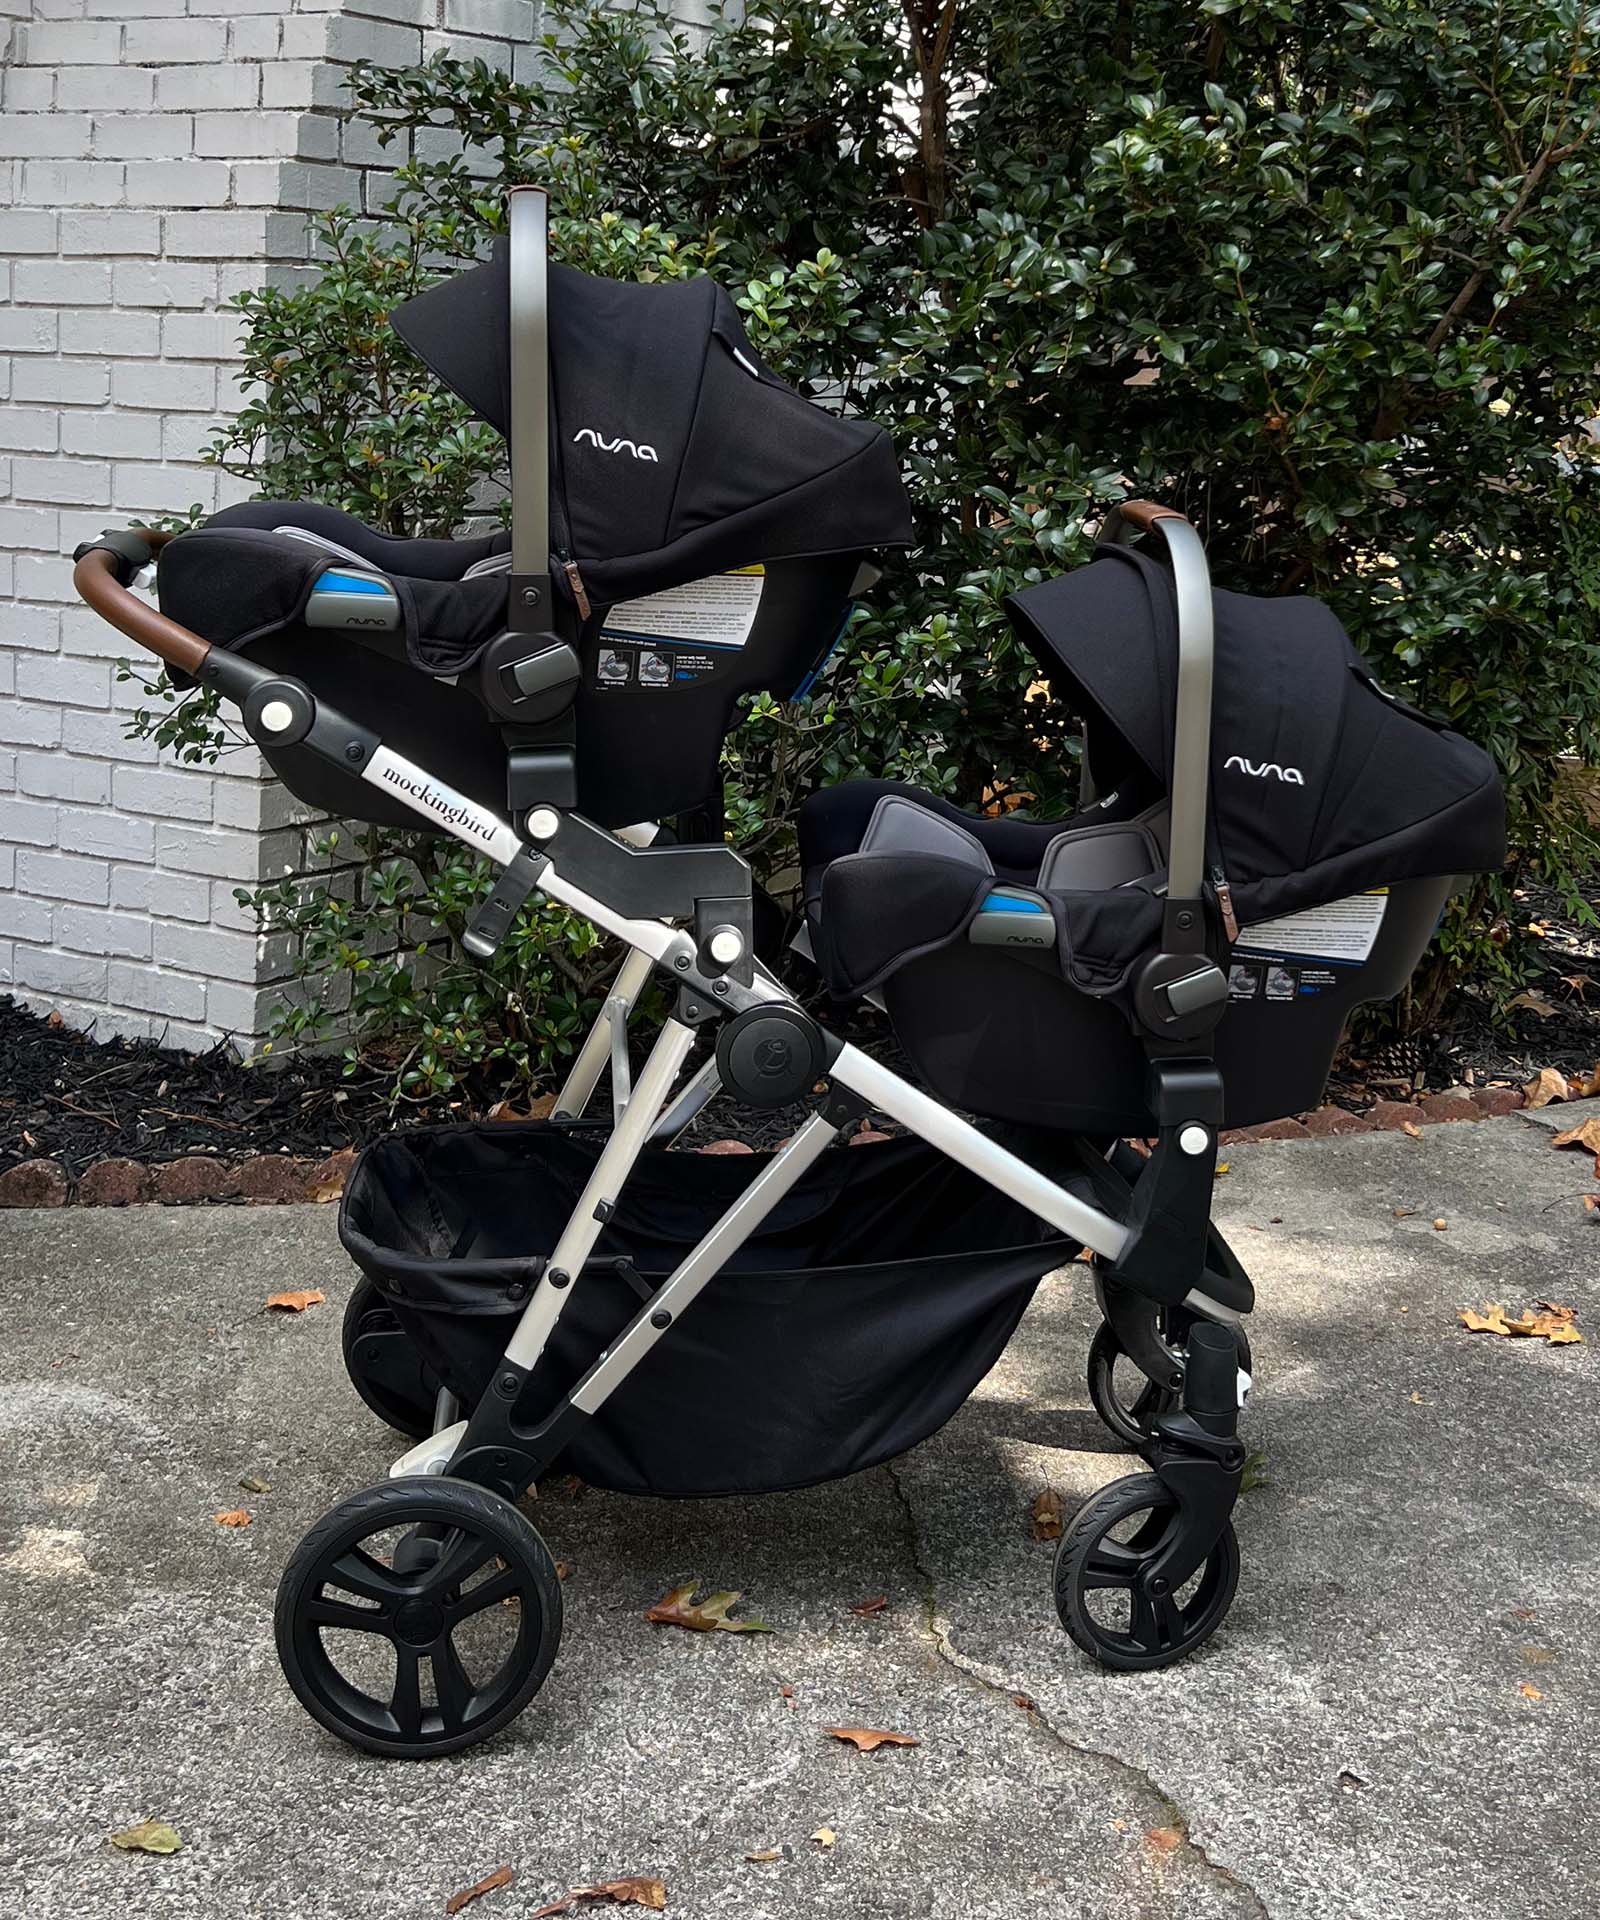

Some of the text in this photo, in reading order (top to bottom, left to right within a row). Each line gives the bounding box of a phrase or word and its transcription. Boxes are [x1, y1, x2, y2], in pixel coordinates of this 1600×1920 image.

[573, 428, 658, 463] nuna
[1223, 755, 1305, 786] nuna
[382, 767, 498, 841] mockingbird
